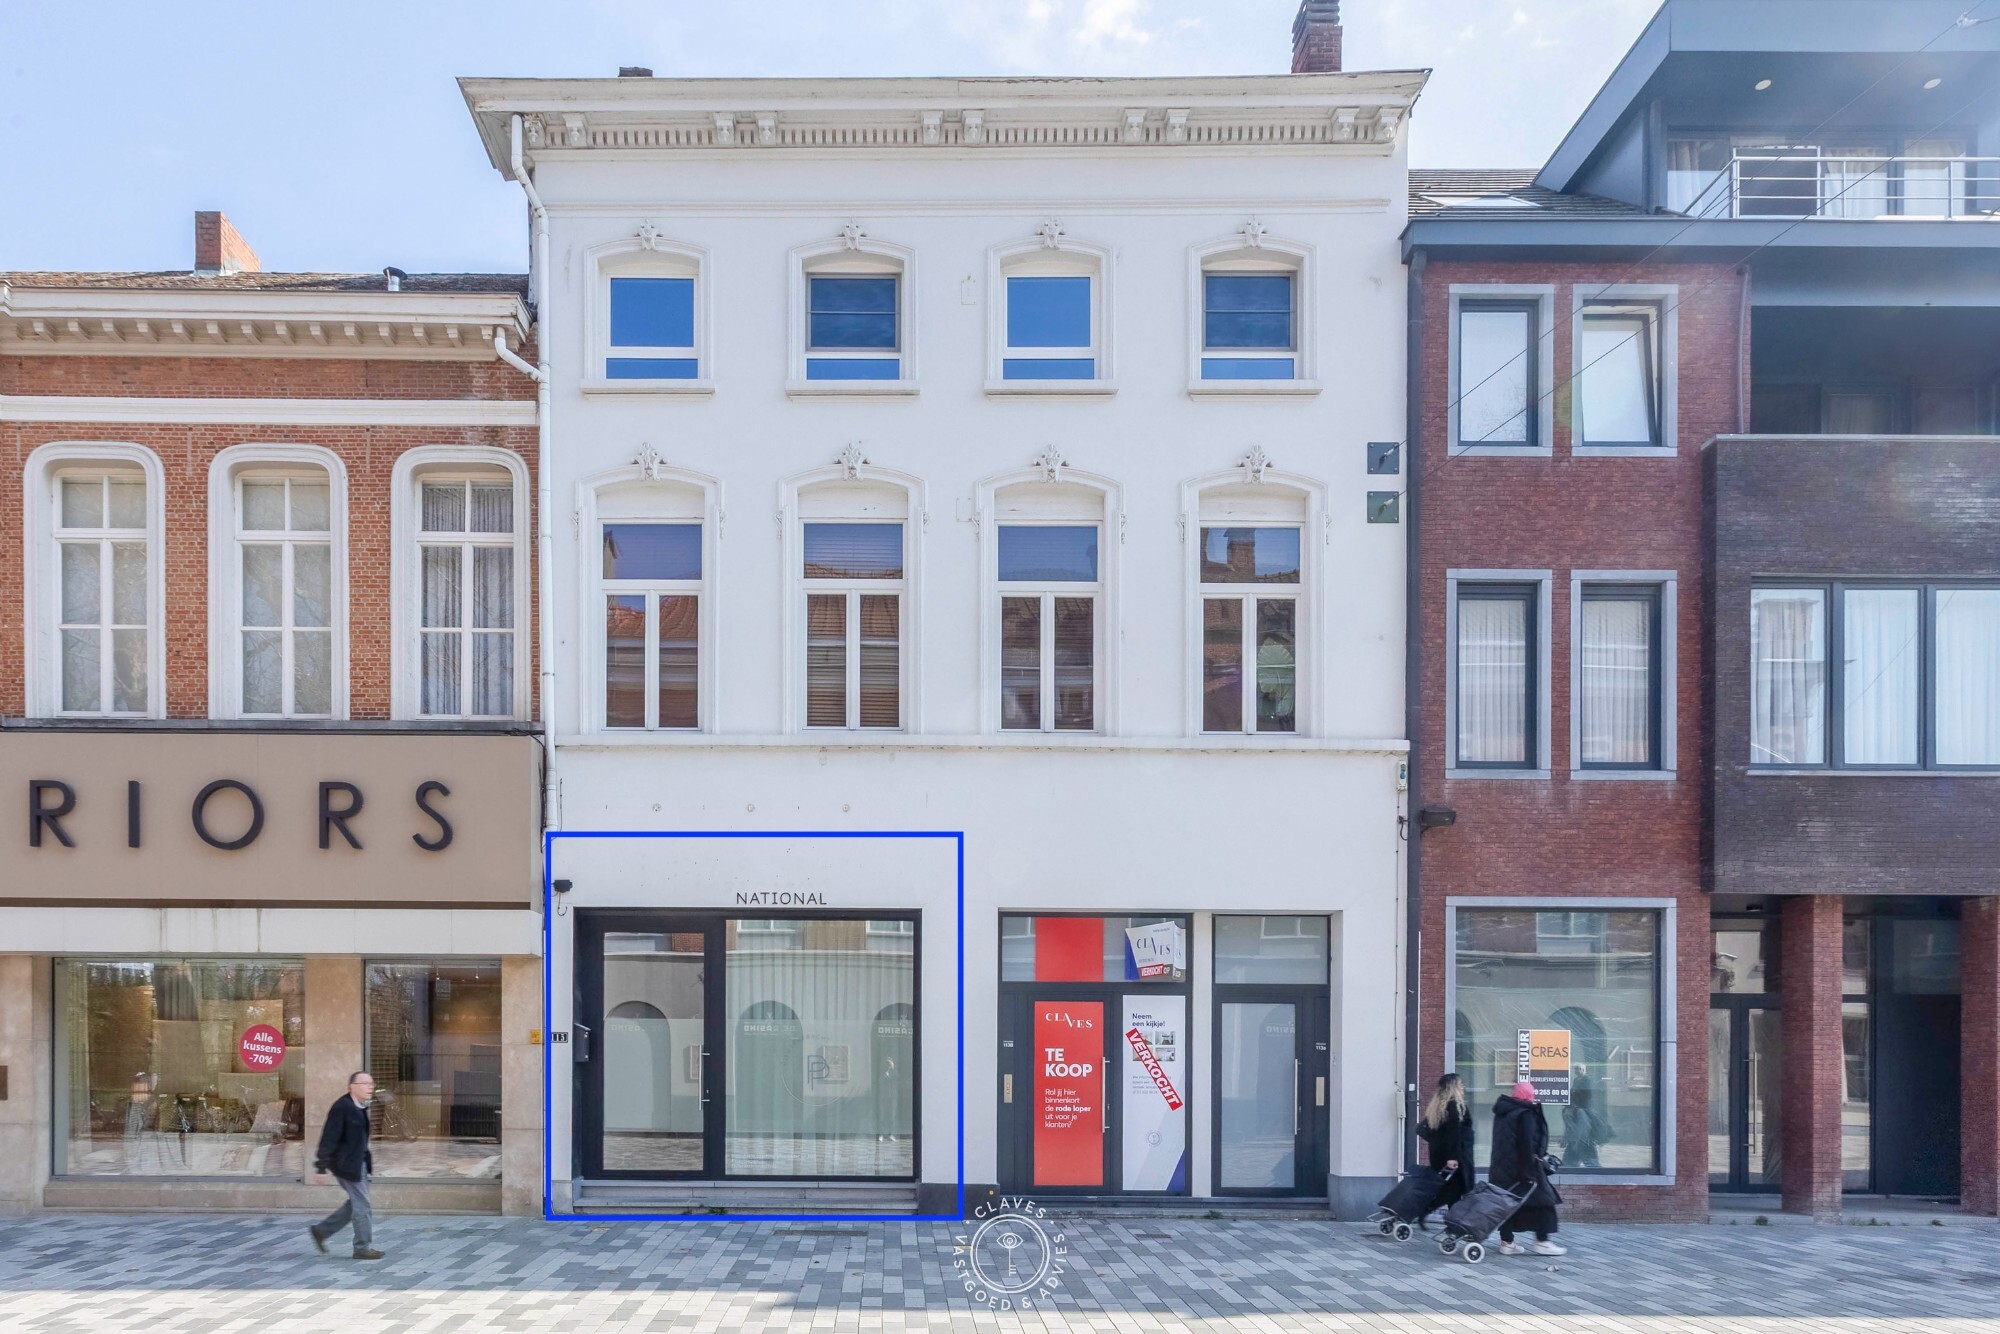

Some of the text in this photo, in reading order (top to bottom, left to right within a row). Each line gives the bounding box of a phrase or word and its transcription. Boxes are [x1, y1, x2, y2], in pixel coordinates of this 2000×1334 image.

[29, 779, 454, 852] RIORS
[736, 892, 828, 905] NATIONAL
[1045, 1012, 1093, 1028] CLAVES
[1146, 1020, 1166, 1028] kijkje!
[254, 1032, 273, 1043] Alle
[243, 1040, 282, 1054] kussens
[1520, 1033, 1530, 1071] HUUR
[1531, 1046, 1569, 1058] CREAS
[249, 1054, 273, 1065] -70%
[1044, 1048, 1065, 1062] TE
[1045, 1063, 1093, 1077] KOOP
[1129, 1031, 1180, 1104] VERKOCHT
[1072, 1104, 1091, 1113] loper
[1071, 1113, 1078, 1122] je
